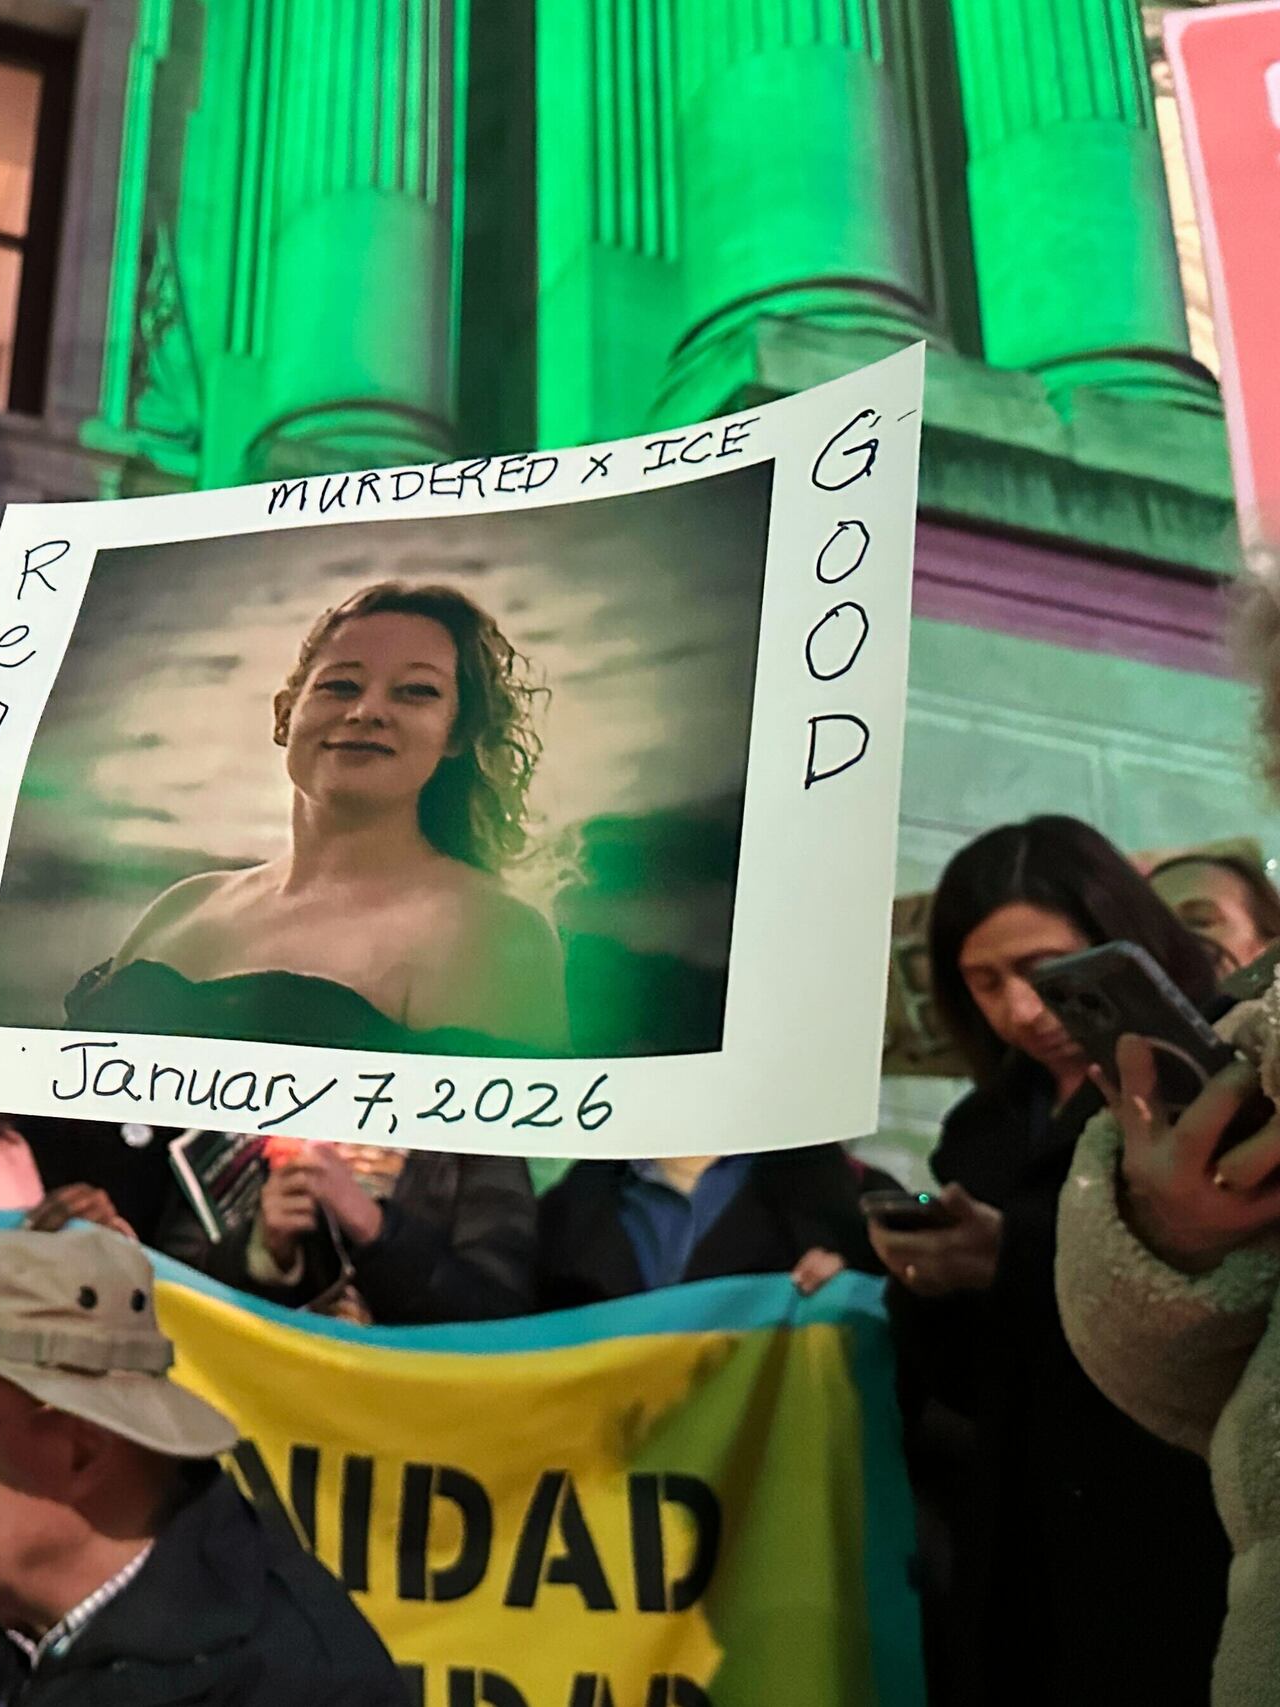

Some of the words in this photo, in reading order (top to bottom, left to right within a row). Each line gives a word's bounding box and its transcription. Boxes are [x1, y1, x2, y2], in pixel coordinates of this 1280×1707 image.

[267, 454, 559, 515] MURDERED
[642, 416, 761, 472] ICE
[803, 408, 882, 791] GOOD
[51, 1040, 339, 1131] January
[353, 1070, 399, 1135] 7,
[415, 1072, 613, 1131] 2026
